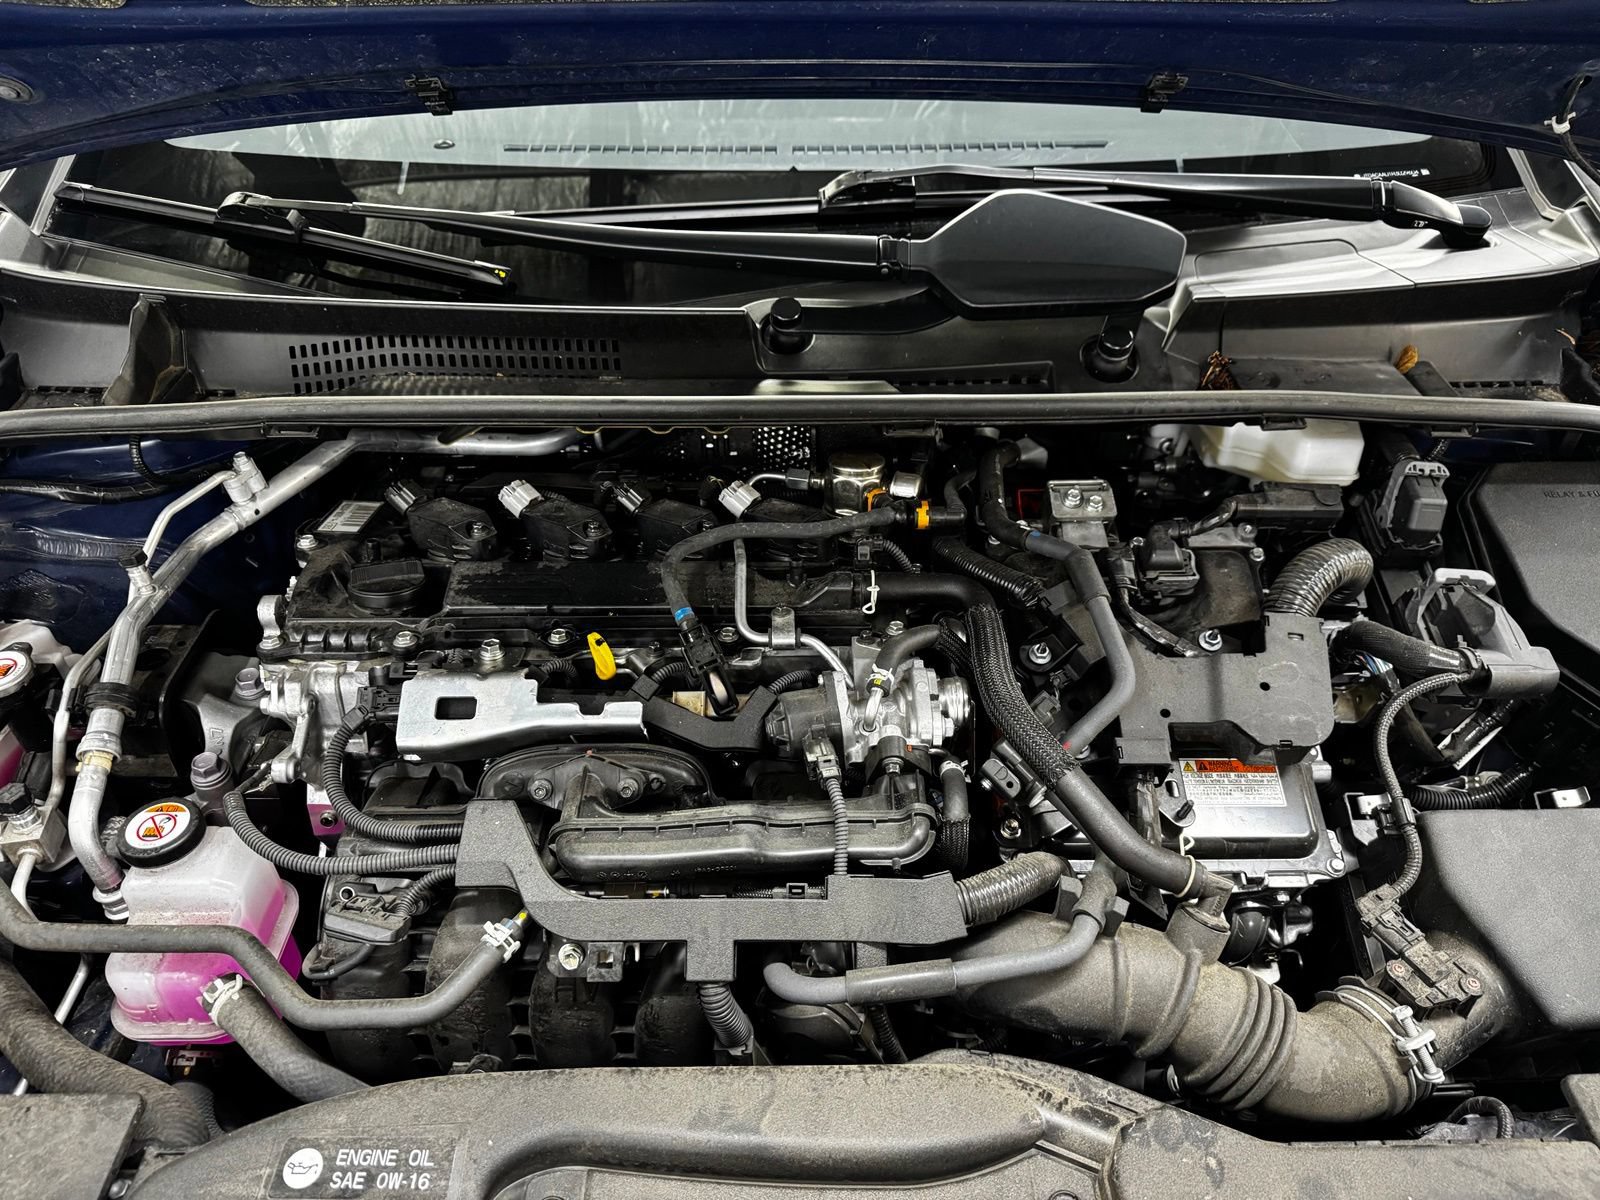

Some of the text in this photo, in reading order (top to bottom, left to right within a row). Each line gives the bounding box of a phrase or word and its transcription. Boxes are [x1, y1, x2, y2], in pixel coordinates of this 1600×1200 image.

[336, 1149, 434, 1166] ENGINE OIL
[330, 1171, 367, 1189] SAE
